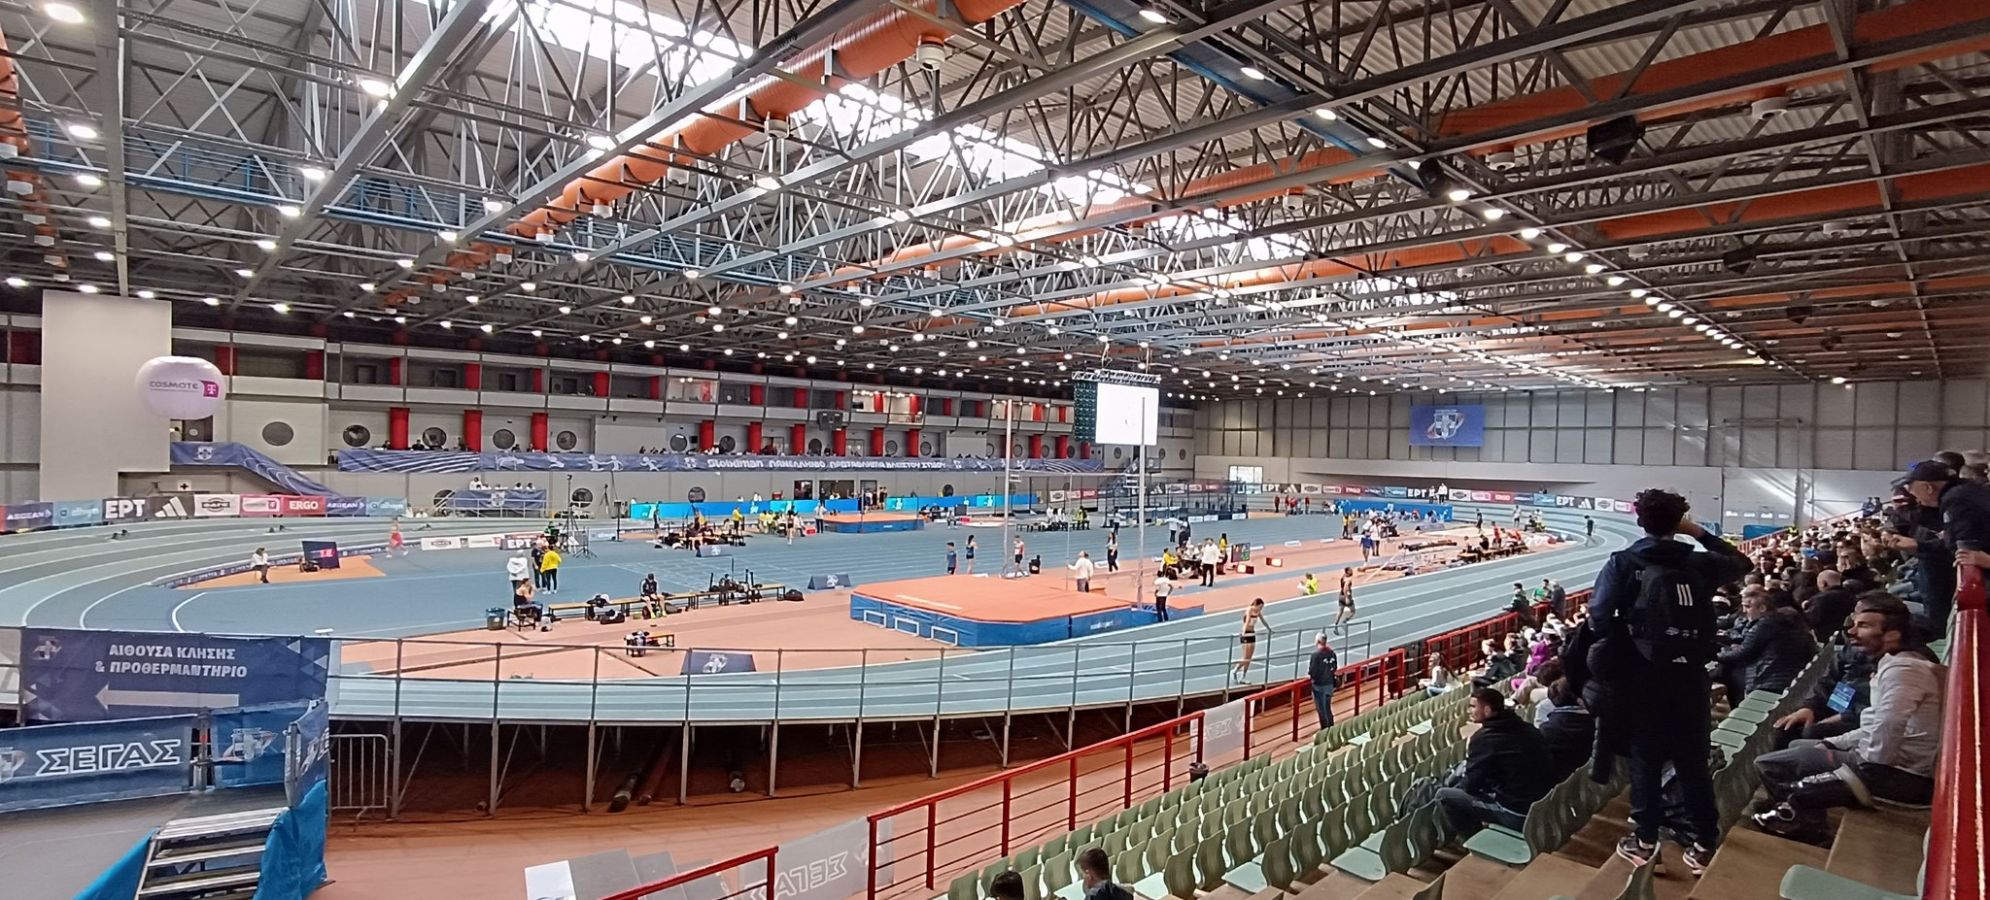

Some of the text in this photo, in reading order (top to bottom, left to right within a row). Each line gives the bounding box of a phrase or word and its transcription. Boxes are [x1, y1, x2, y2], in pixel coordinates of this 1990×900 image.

[289, 501, 319, 510] ERGO
[109, 644, 236, 660] ΑΙΘΟΥΣΑ ΚΛΗΣΗΣ
[95, 661, 248, 678] & ΠΡΟΘΕΡΜΑΝΤΗΡΙΟ
[35, 739, 181, 777] ΣΕΓΑΣ
